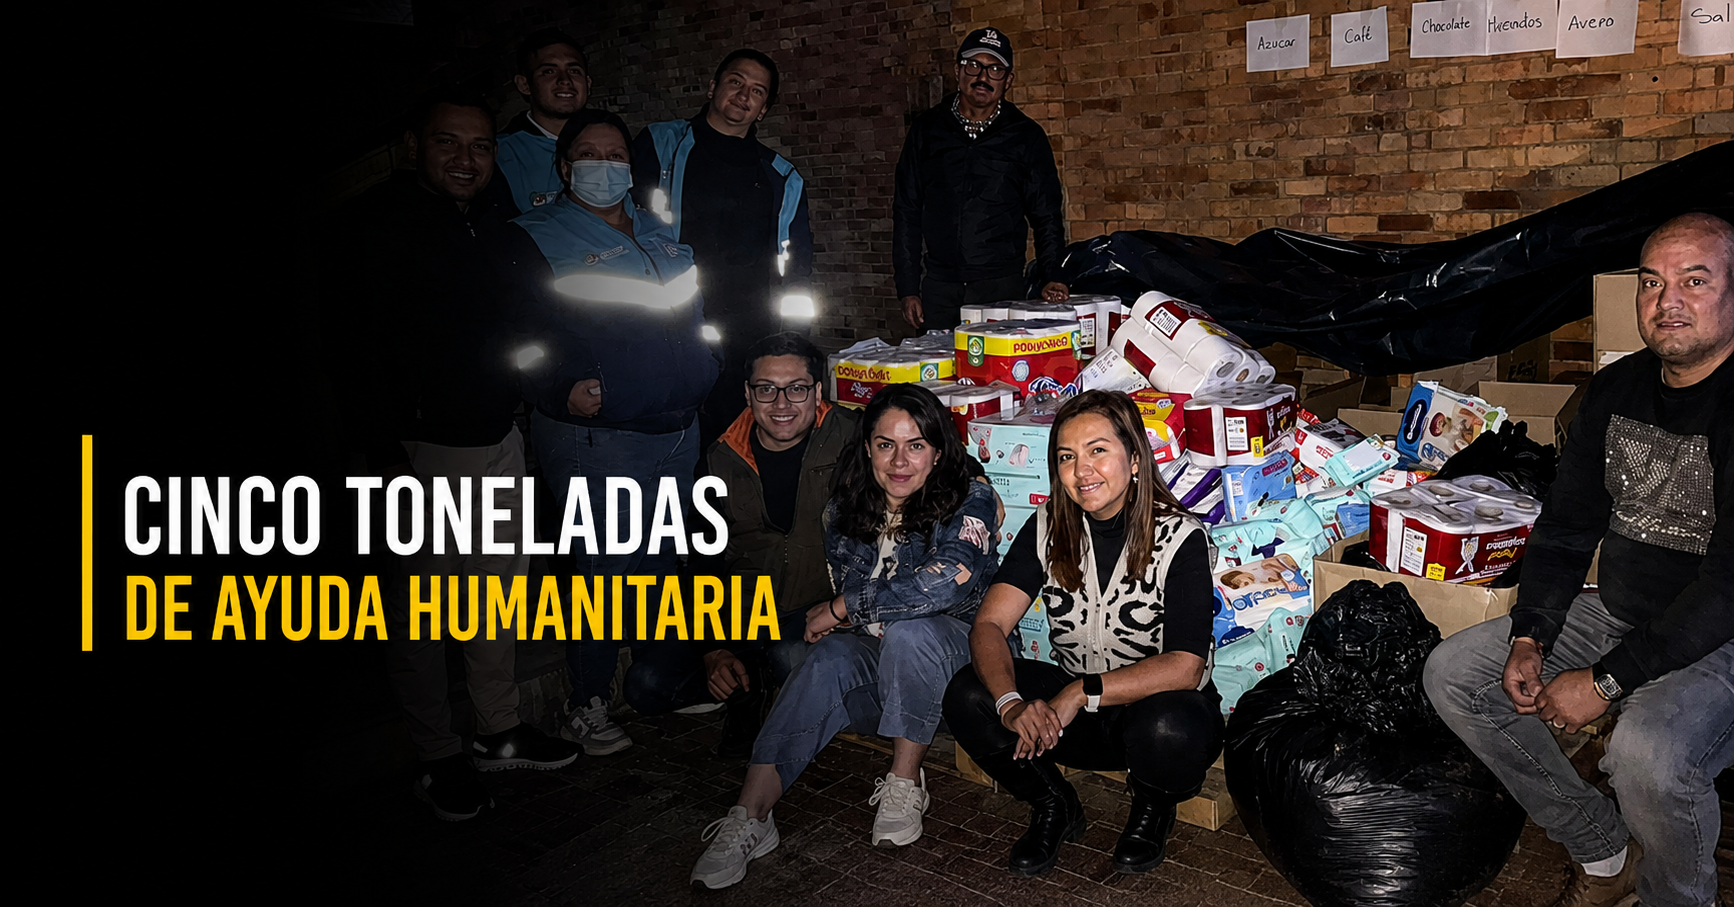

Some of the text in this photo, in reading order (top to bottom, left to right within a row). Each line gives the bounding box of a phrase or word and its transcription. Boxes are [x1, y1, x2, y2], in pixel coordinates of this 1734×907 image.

[1690, 3, 1730, 24] Sal
[1421, 16, 1471, 34] Chocolate
[1257, 36, 1296, 50] Azucar
[1344, 26, 1373, 44] Café
